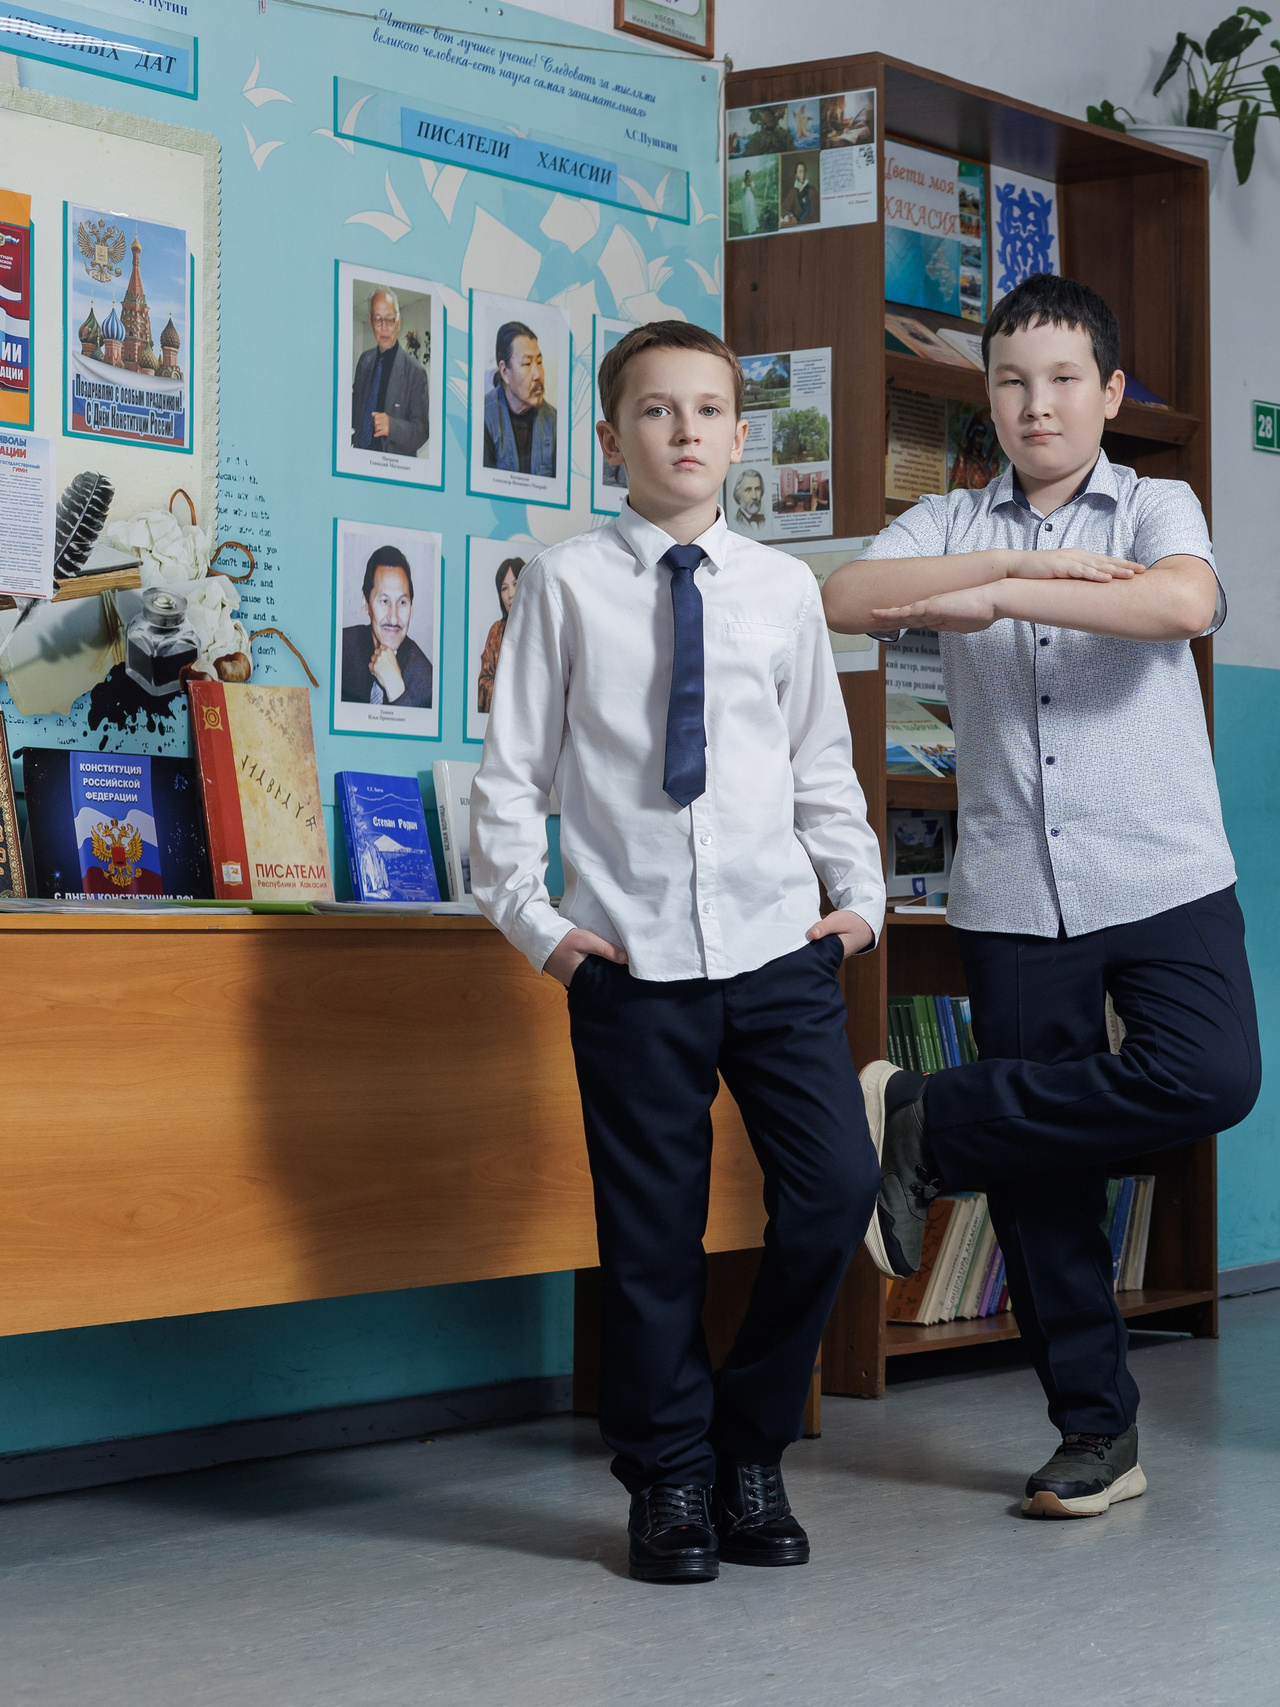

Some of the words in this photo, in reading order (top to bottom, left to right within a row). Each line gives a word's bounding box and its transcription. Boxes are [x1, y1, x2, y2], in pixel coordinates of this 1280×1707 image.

[134, 50, 177, 74] ДАТ
[433, 26, 453, 44] вот
[457, 38, 496, 56] лучшее
[499, 49, 538, 68] учение!
[540, 54, 596, 86] Следовать
[599, 79, 609, 90] за
[612, 82, 657, 104] мыслями
[372, 27, 419, 54] великого
[499, 68, 531, 87] наука
[533, 77, 566, 95] самая
[567, 86, 647, 118] занимательная»
[417, 120, 511, 160] ПИСАТЕЛИ
[536, 151, 613, 186] ХАКАСИИ
[928, 176, 955, 195] моя
[884, 196, 958, 235] ХАКАСИЯ
[1258, 414, 1273, 439] 28
[12, 466, 28, 474] ГИМН
[242, 560, 259, 570] mid
[260, 580, 274, 589] and
[253, 612, 266, 621] and
[900, 663, 919, 673] ветер,
[895, 680, 912, 690] духов
[914, 682, 936, 691] родной
[80, 763, 142, 776] КОНСТИТУЦИЯ
[83, 777, 140, 789] РОССИЙСКОЙ
[85, 791, 138, 803] ФЕДЕРАЦИИ
[372, 816, 396, 829] Степан
[398, 818, 418, 831] Родин
[255, 863, 326, 879] ПИСАТЕЛИ
[257, 880, 297, 889] Республики
